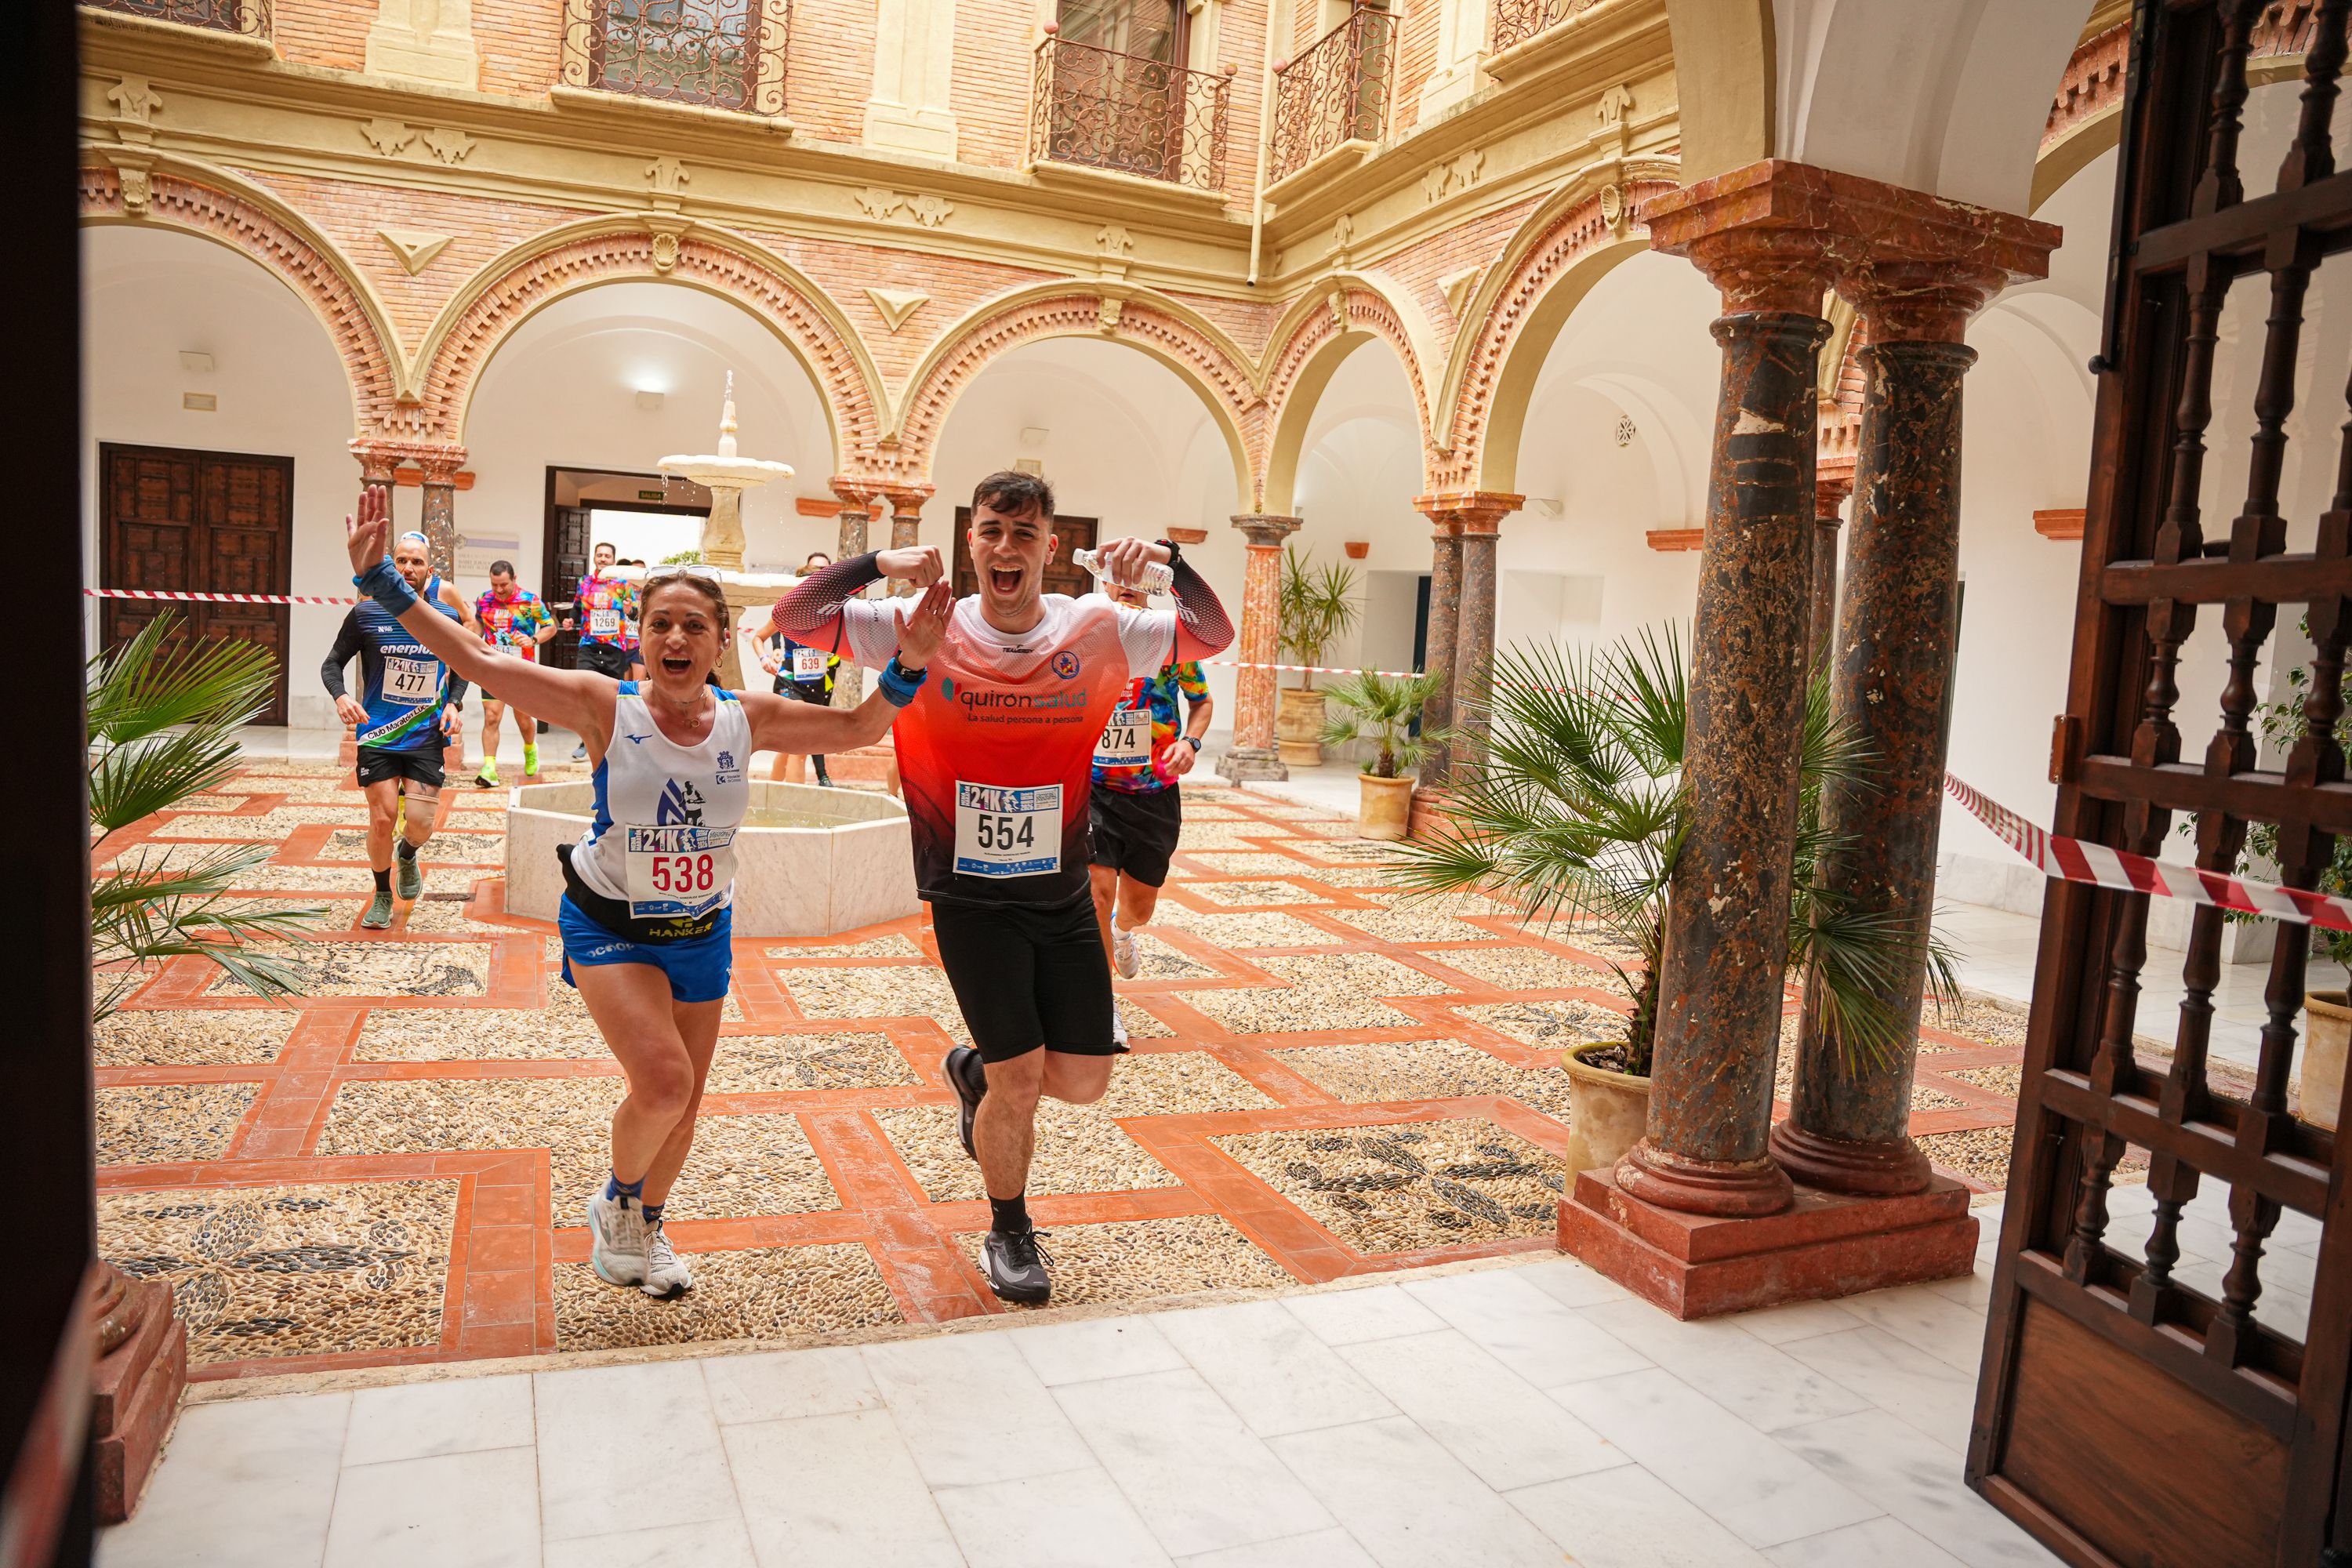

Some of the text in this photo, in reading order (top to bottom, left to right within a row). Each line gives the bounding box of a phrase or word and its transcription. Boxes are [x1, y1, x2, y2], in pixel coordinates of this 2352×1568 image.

[595, 618, 615, 627] 1269
[802, 658, 819, 670] 639
[395, 673, 426, 691] 477
[980, 714, 1004, 723] salud
[1007, 715, 1043, 724] persona
[1053, 716, 1083, 724] persona
[368, 728, 386, 739] Club
[1102, 728, 1135, 749] 874
[971, 786, 1002, 811] 21K
[643, 829, 680, 851] 21K
[978, 814, 1034, 850] 554
[652, 854, 713, 893] 538
